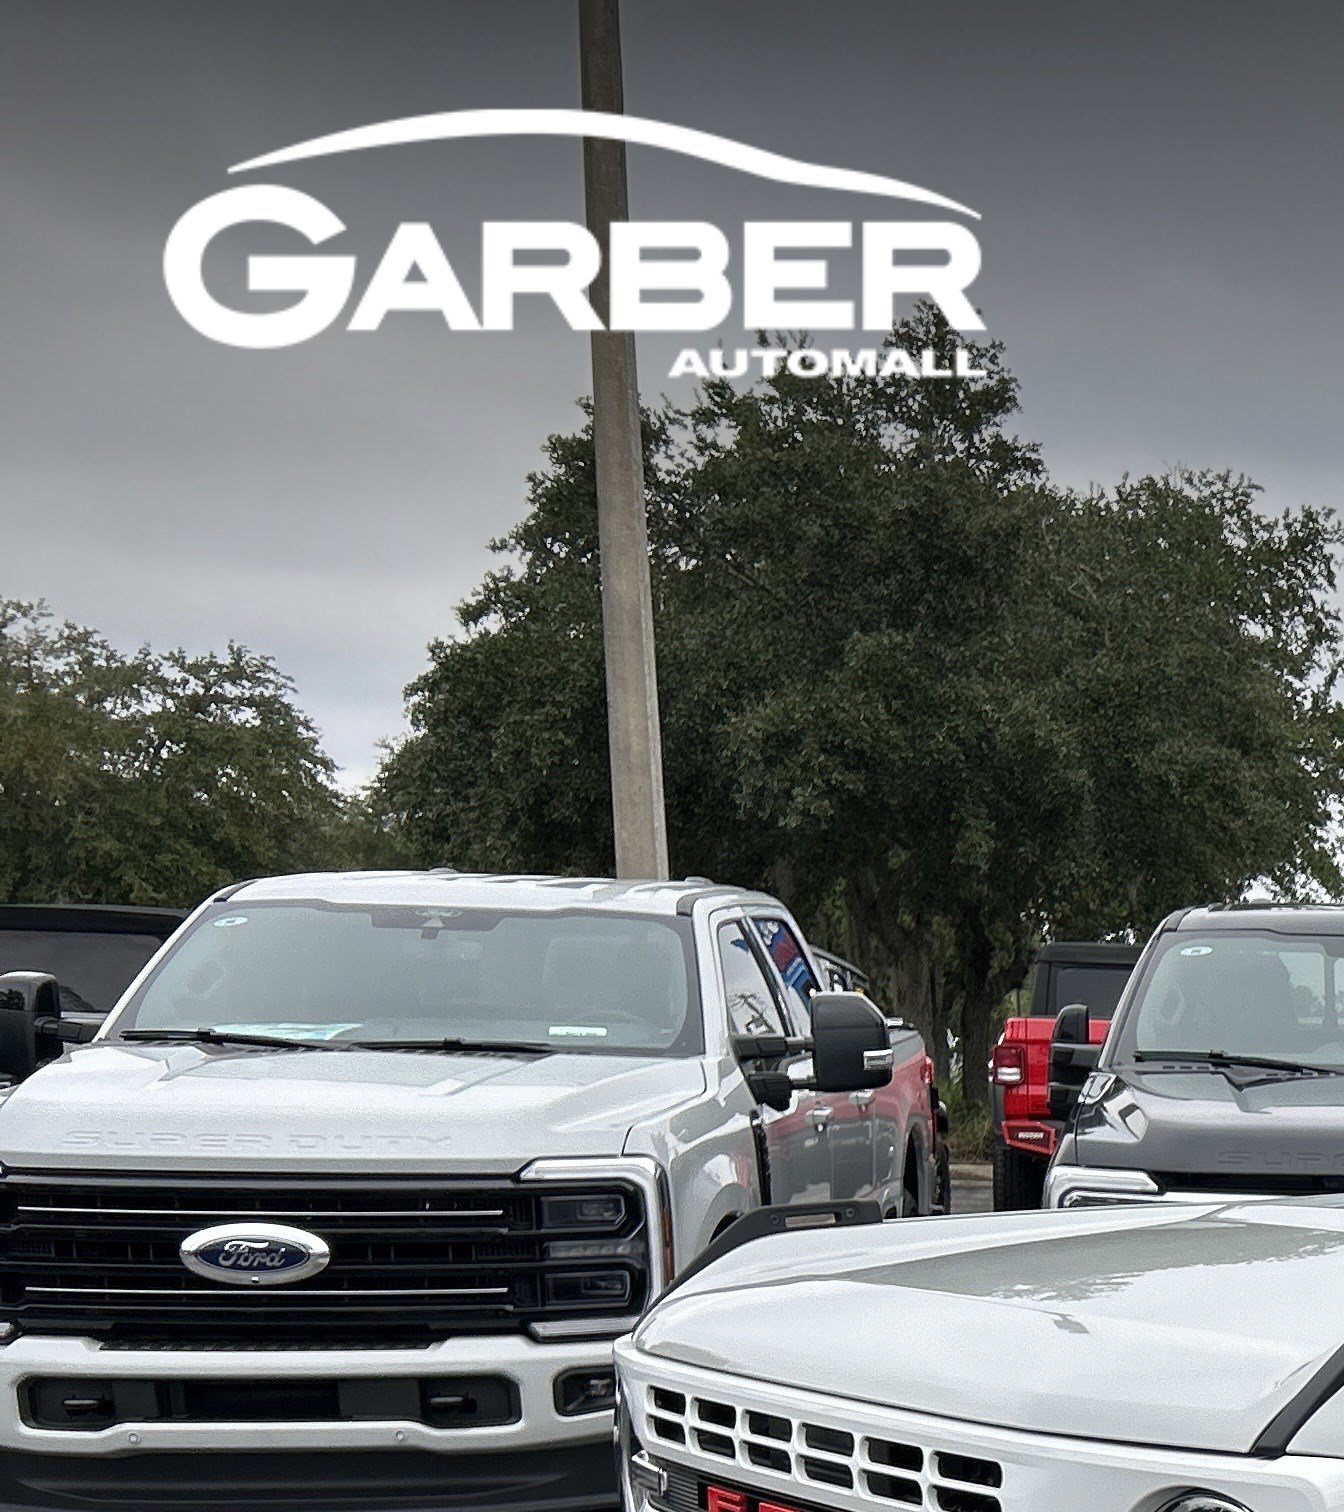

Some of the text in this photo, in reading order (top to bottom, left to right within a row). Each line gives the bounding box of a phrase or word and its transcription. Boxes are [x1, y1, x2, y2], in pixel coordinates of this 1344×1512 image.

[62, 1130, 452, 1151] SUPER DUTY
[219, 1240, 287, 1268] Ford
